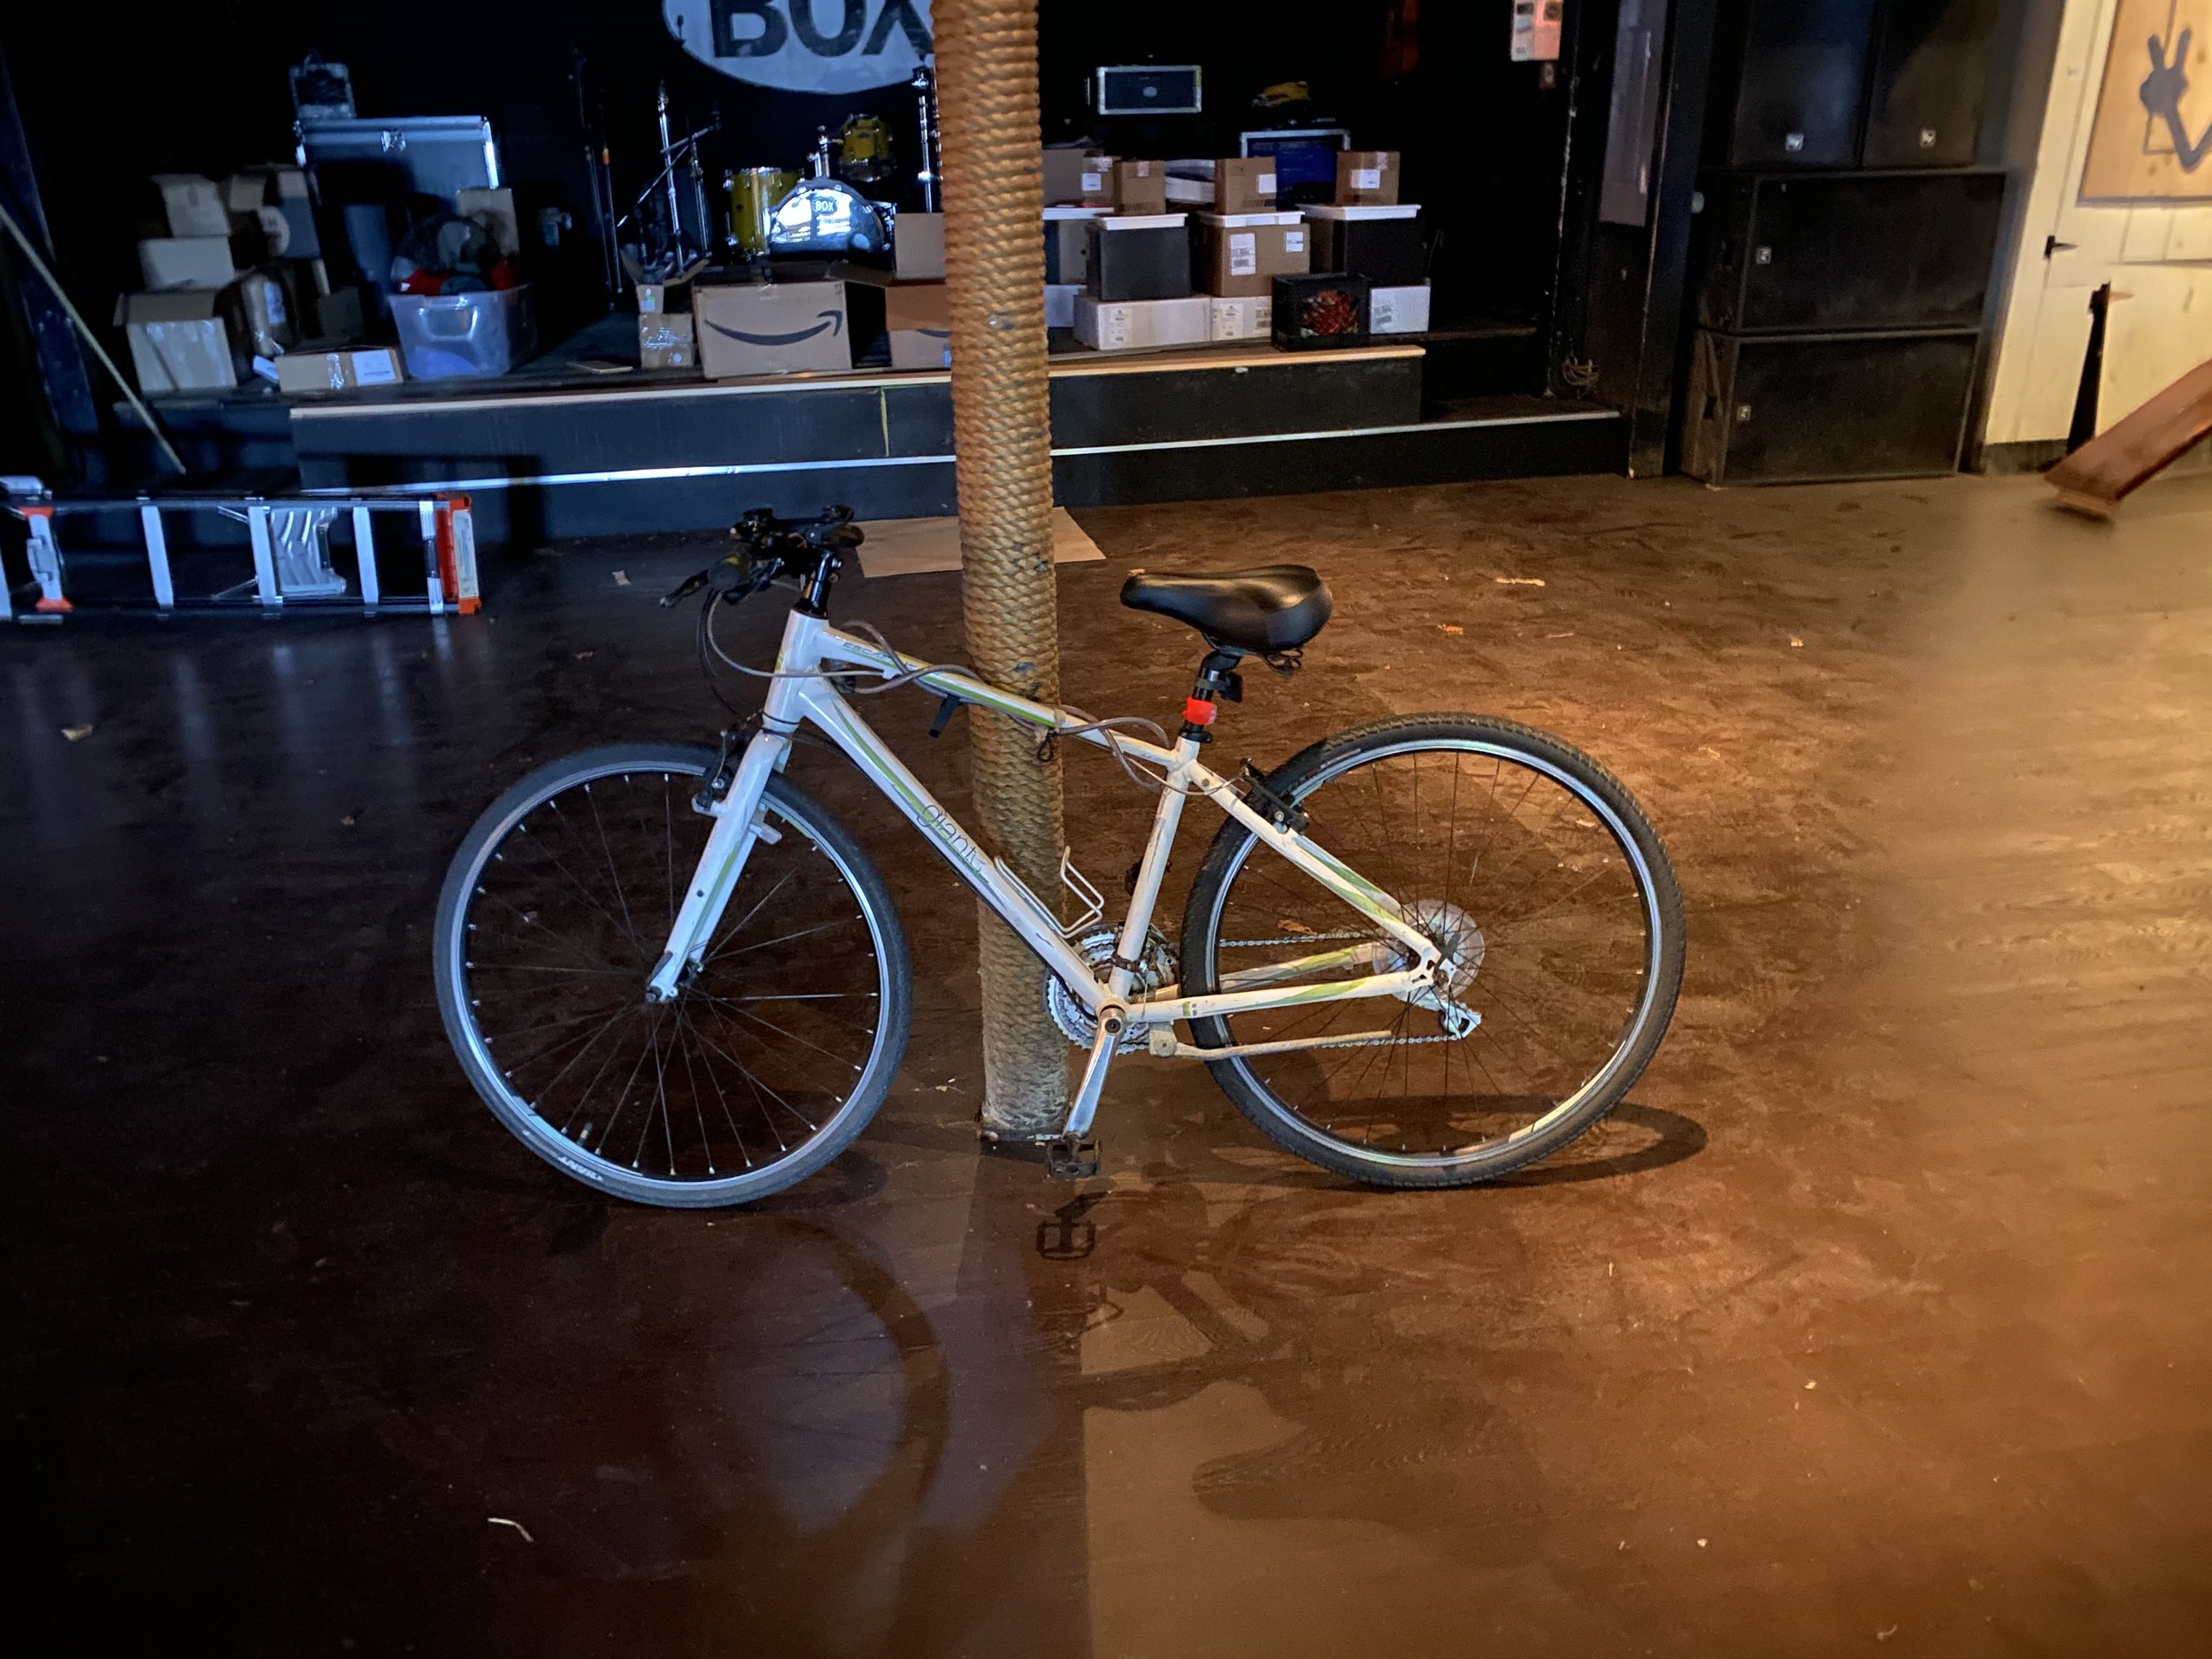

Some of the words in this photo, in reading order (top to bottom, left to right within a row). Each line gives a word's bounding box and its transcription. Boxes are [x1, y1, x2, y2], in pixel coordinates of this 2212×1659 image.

[710, 0, 934, 58] BOX
[815, 200, 834, 212] BOX
[917, 804, 978, 860] giant
